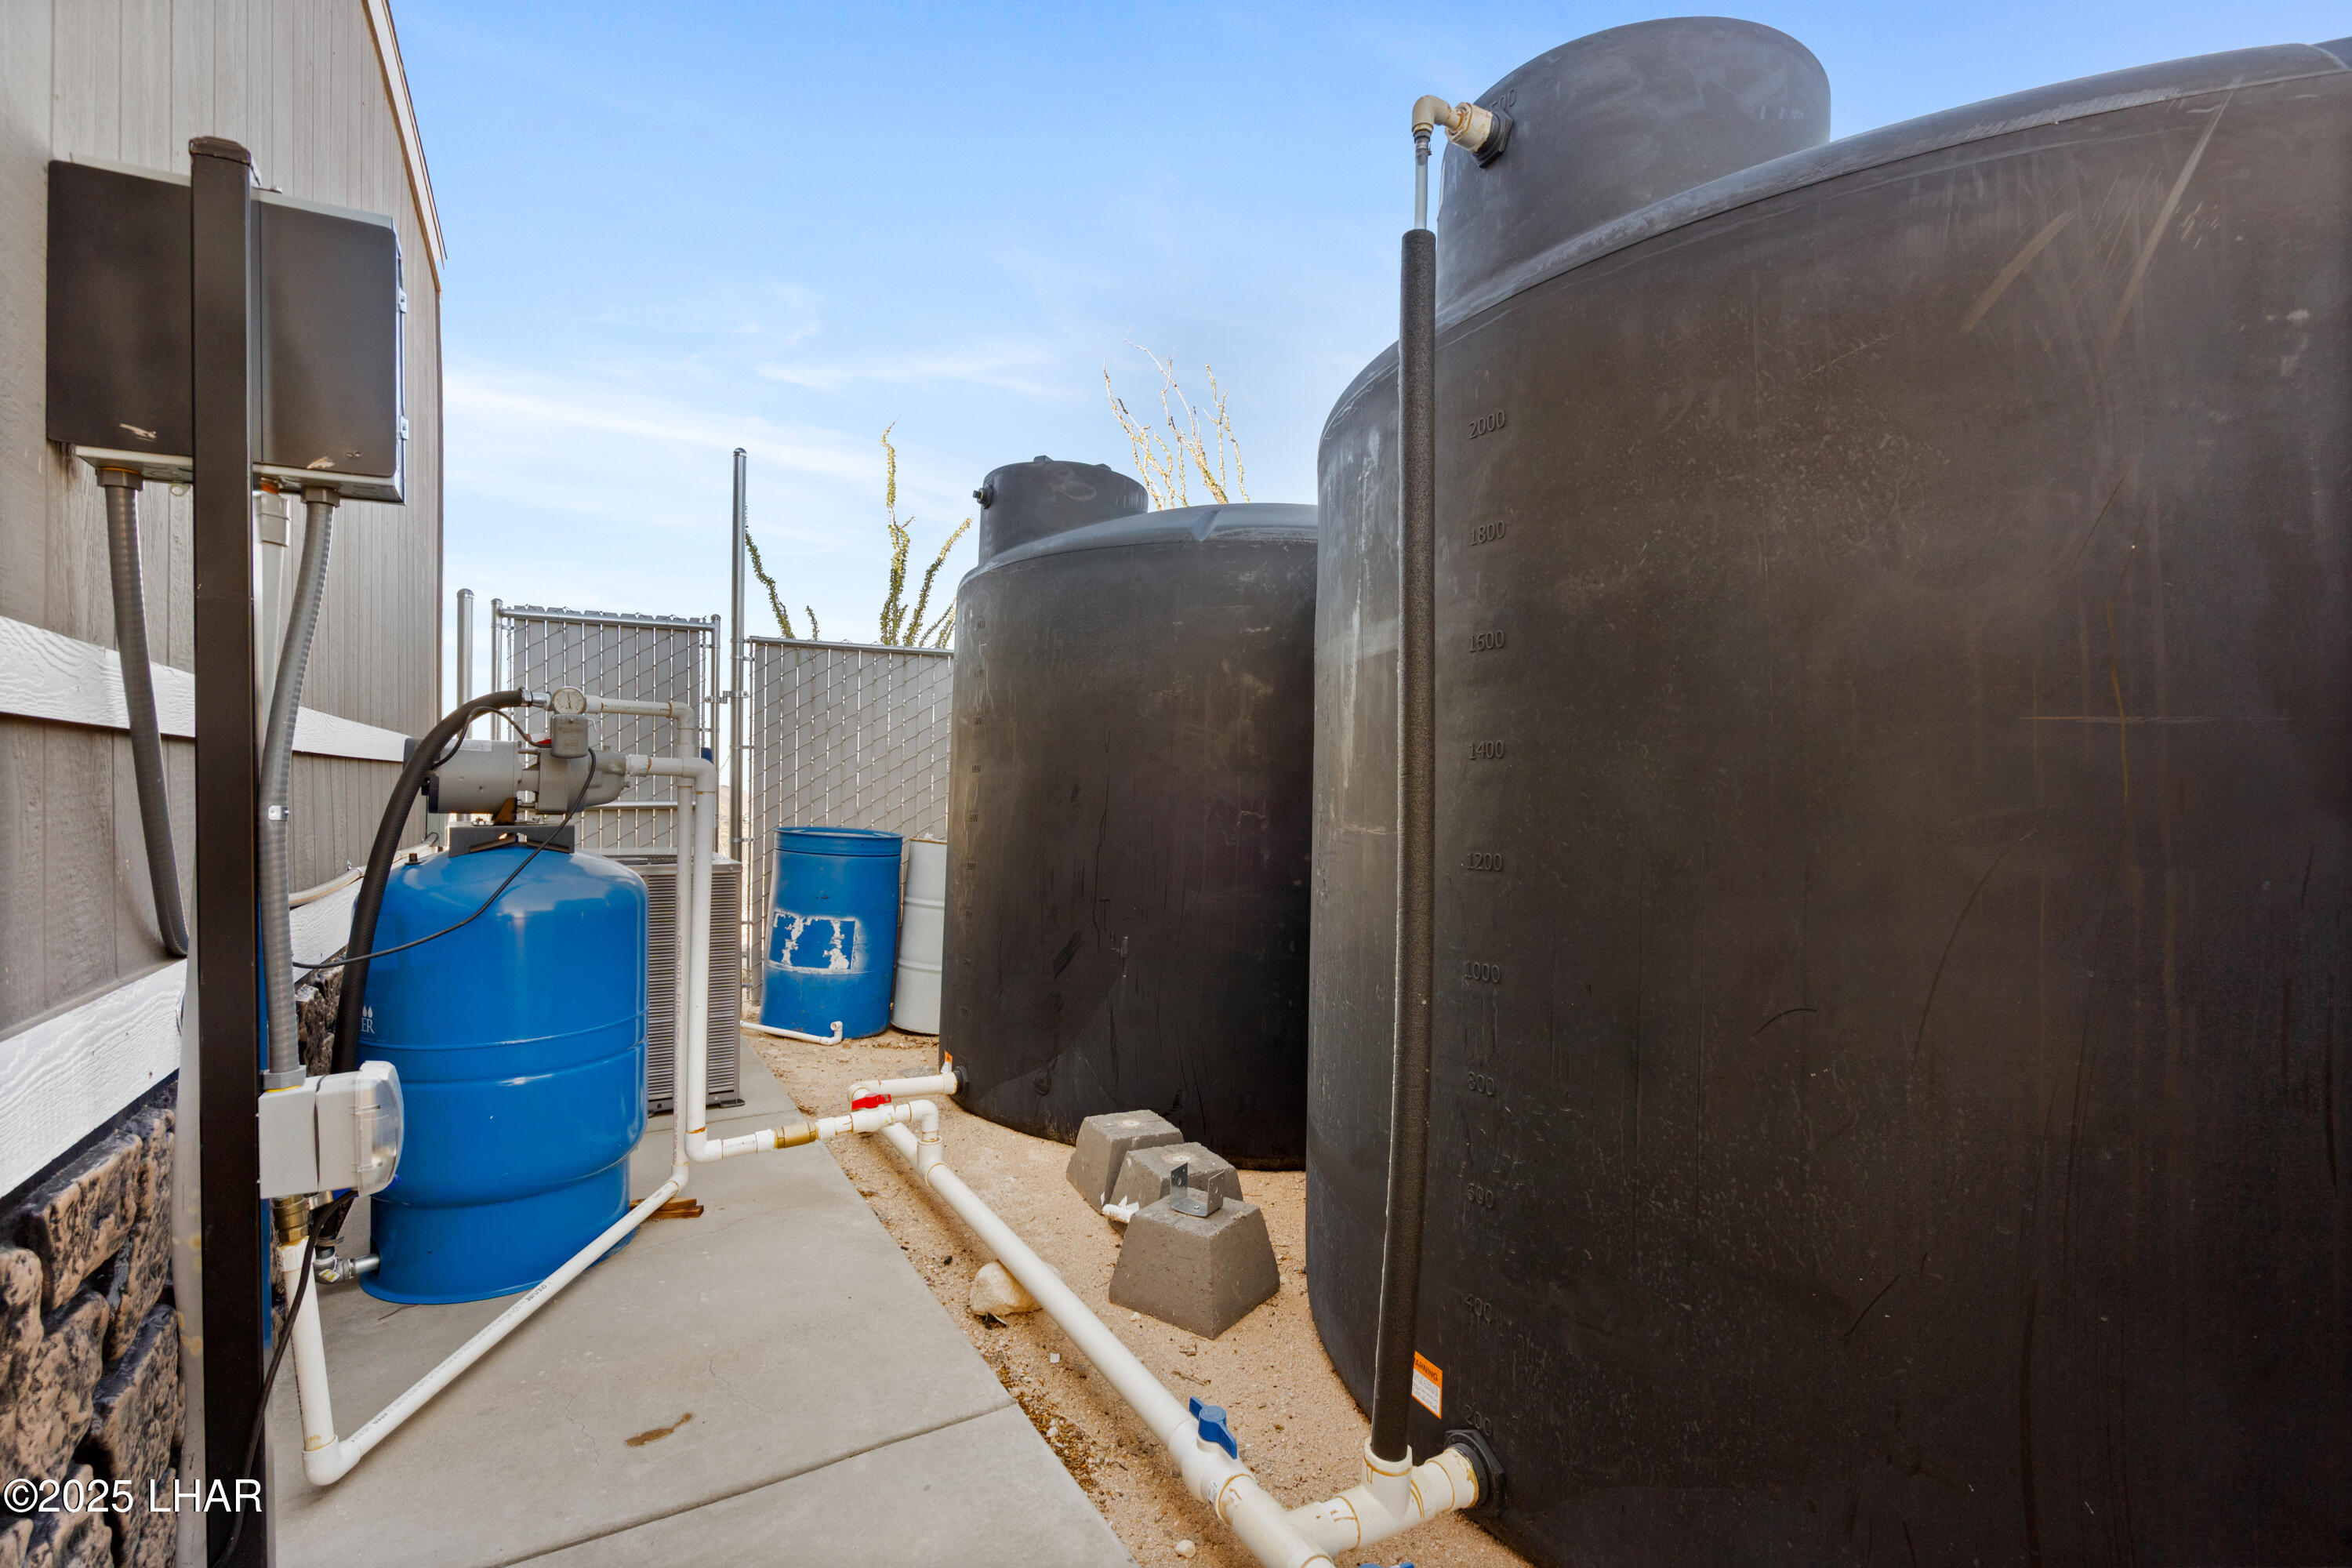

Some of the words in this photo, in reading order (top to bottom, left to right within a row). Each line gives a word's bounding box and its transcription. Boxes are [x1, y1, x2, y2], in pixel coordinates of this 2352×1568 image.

[1468, 409, 1505, 439] 2000
[1469, 521, 1506, 546] 1800
[1468, 630, 1505, 653] 1600
[1468, 740, 1504, 760] 1400
[1466, 852, 1503, 871] 1200
[1465, 960, 1501, 983] 1000
[1468, 1071, 1494, 1095] 800
[1414, 1359, 1439, 1381] ARNING
